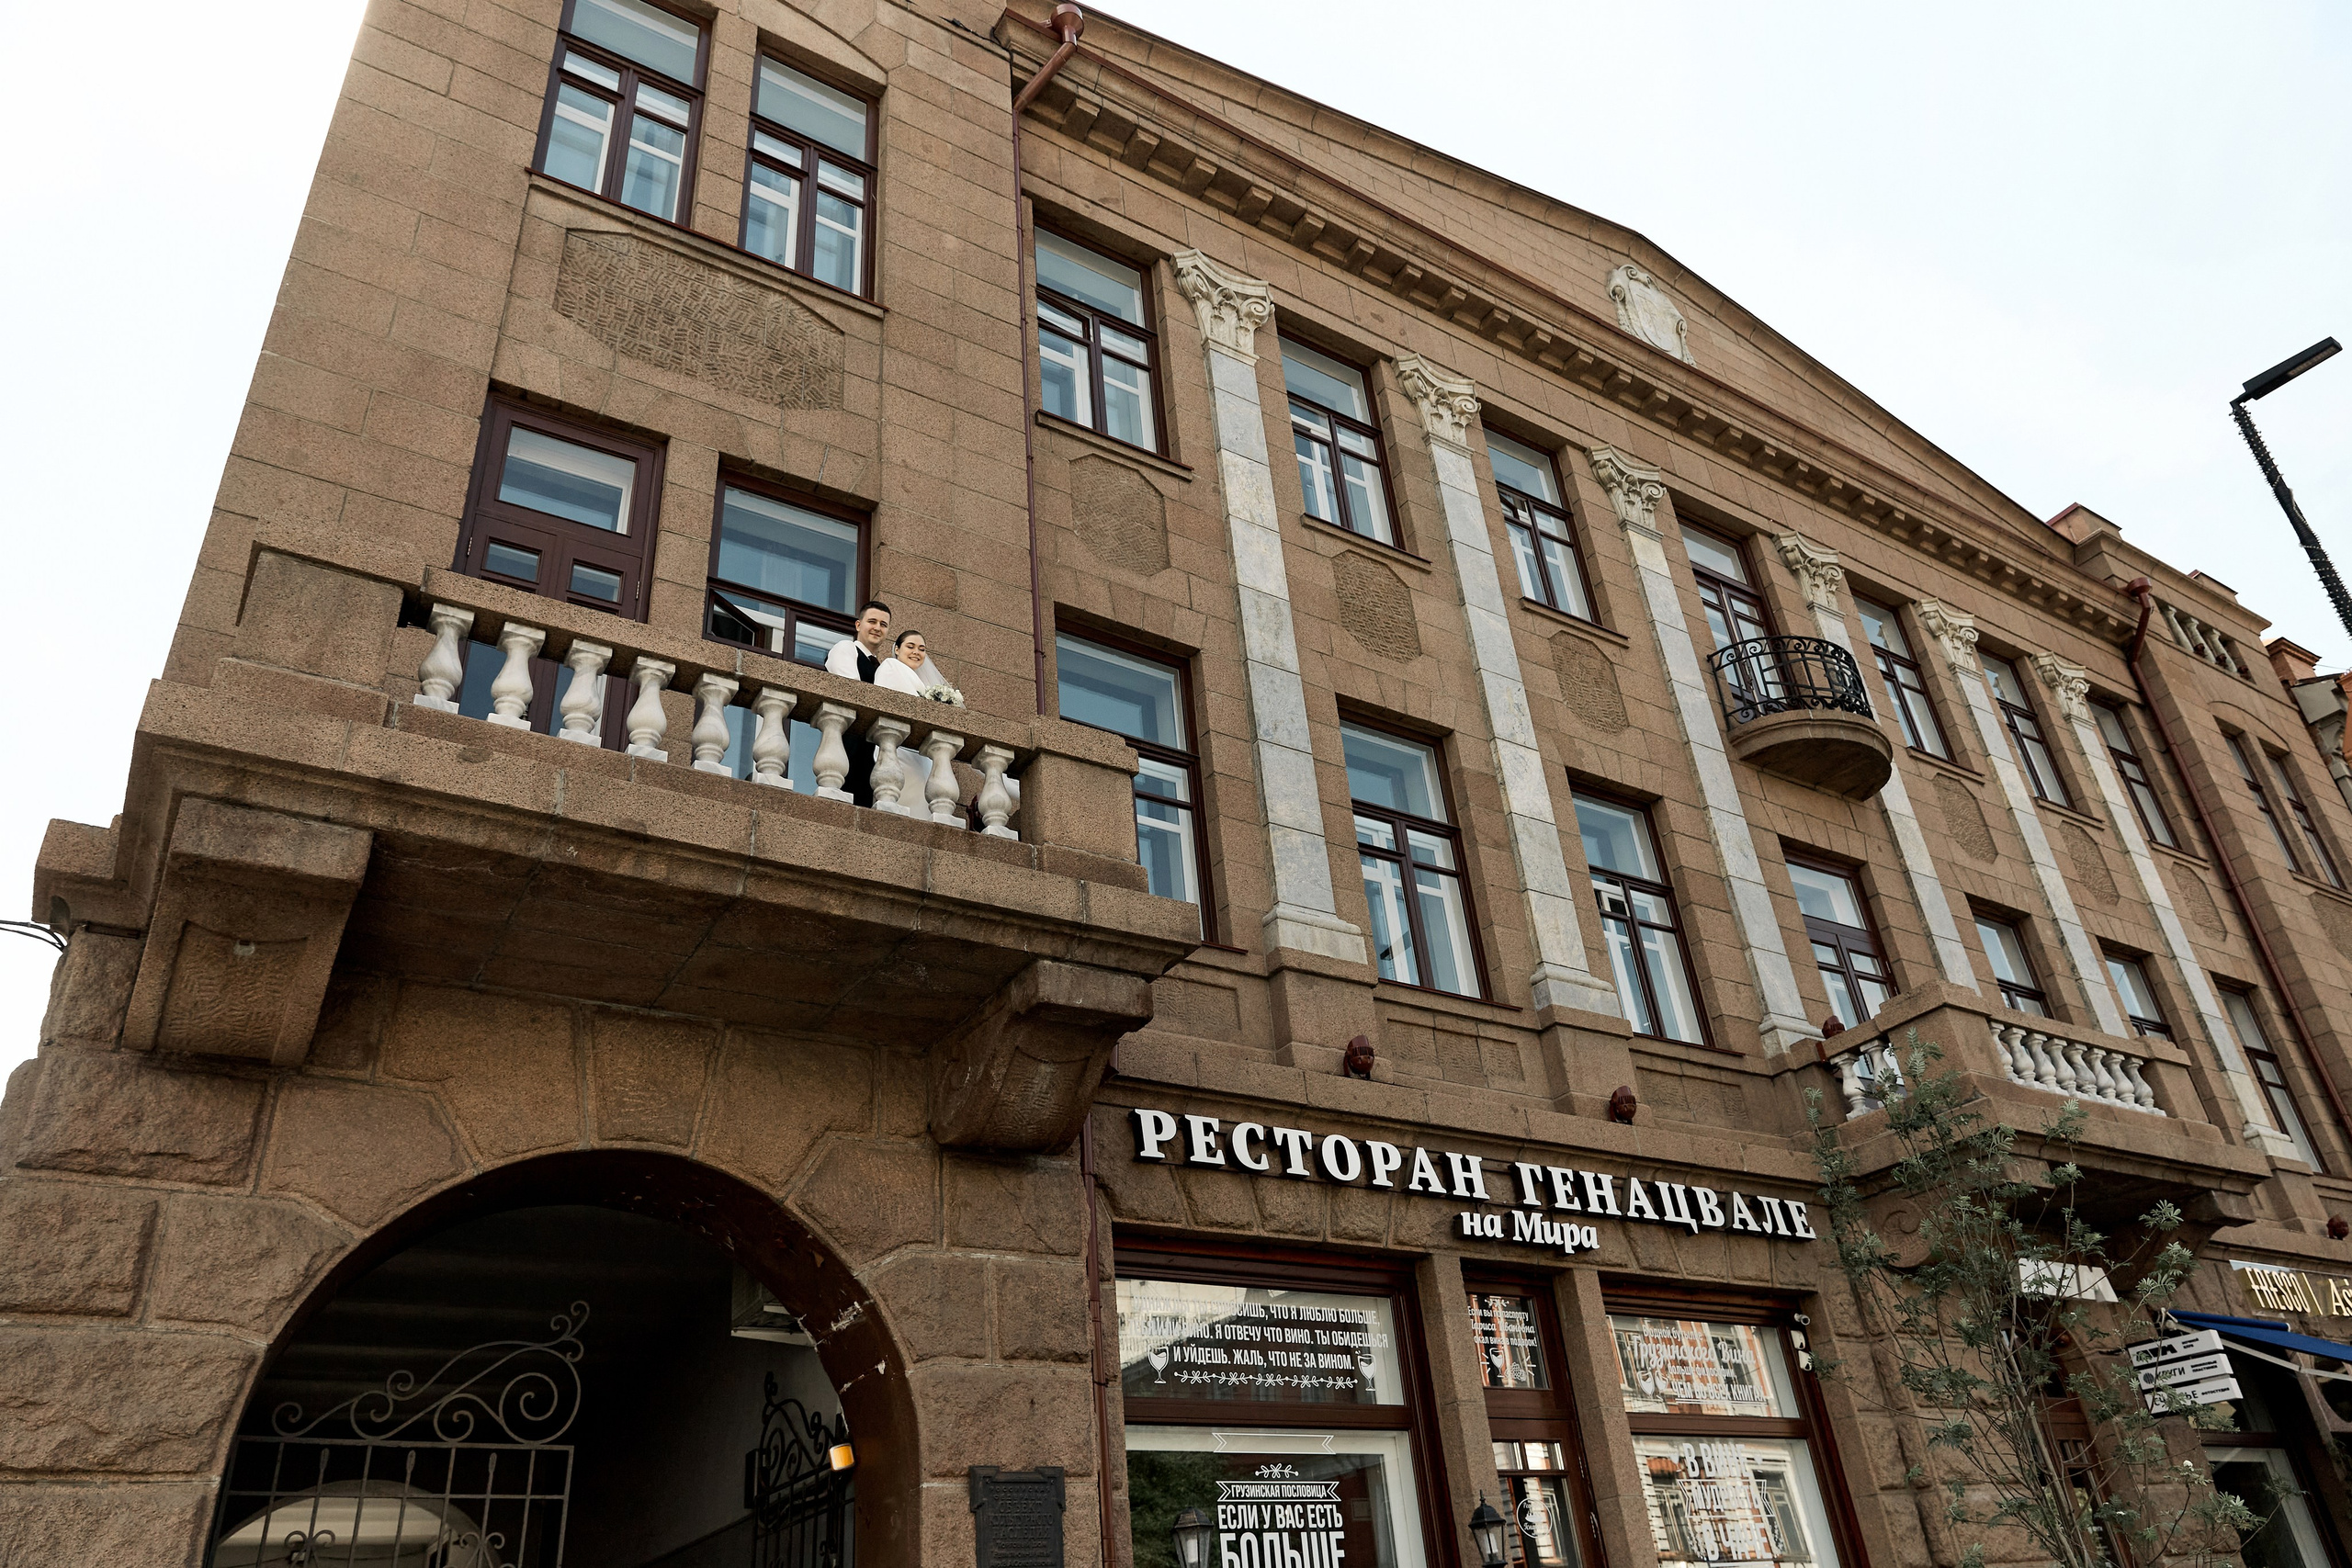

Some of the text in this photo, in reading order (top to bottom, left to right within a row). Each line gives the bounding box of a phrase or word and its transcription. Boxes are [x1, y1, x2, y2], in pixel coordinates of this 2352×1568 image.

[1134, 1108, 1817, 1239] РЕСТОРАН ГЕНАЦВАЛЕ
[1460, 1210, 1600, 1255] на Мира
[2245, 1267, 2352, 1317] FRESCO As
[1270, 1303, 1288, 1320] ЧТО
[1290, 1305, 1297, 1319] Я
[1300, 1305, 1337, 1323] ЛЮБЛЮ
[1339, 1308, 1380, 1326] БОЛЬШЕ,
[1182, 1321, 1213, 1338] ВИНО.
[1215, 1325, 1223, 1339] Я
[1225, 1324, 1261, 1342] ОТВЕЧУ
[1263, 1326, 1283, 1343] ЧТО
[1283, 1327, 1314, 1344] ВИНО.
[1315, 1329, 1329, 1346] ТЫ
[1331, 1330, 1389, 1348] ОБИДЕШЬСЯ
[1474, 1336, 1489, 1344] окал
[1173, 1343, 1355, 1371] И УЙДЕШЬ. ЖАЛЬ, ЧТО НЕ ЗА ВИНОМ.
[1671, 1381, 1693, 1399] ЧЕМ
[1694, 1382, 1707, 1399] ВО
[1708, 1383, 1732, 1400] ВСЕХ
[1683, 1443, 1749, 1477] В ВИНЕ
[1231, 1484, 1327, 1499] ГРУЗИНСКАЯ ПОСЛОВИЦА
[1217, 1504, 1343, 1529] ЕСЛИ У ВАС ЕСТЬ
[1220, 1531, 1345, 1568] БОЛЬШЕ
[1702, 1523, 1719, 1561] В
